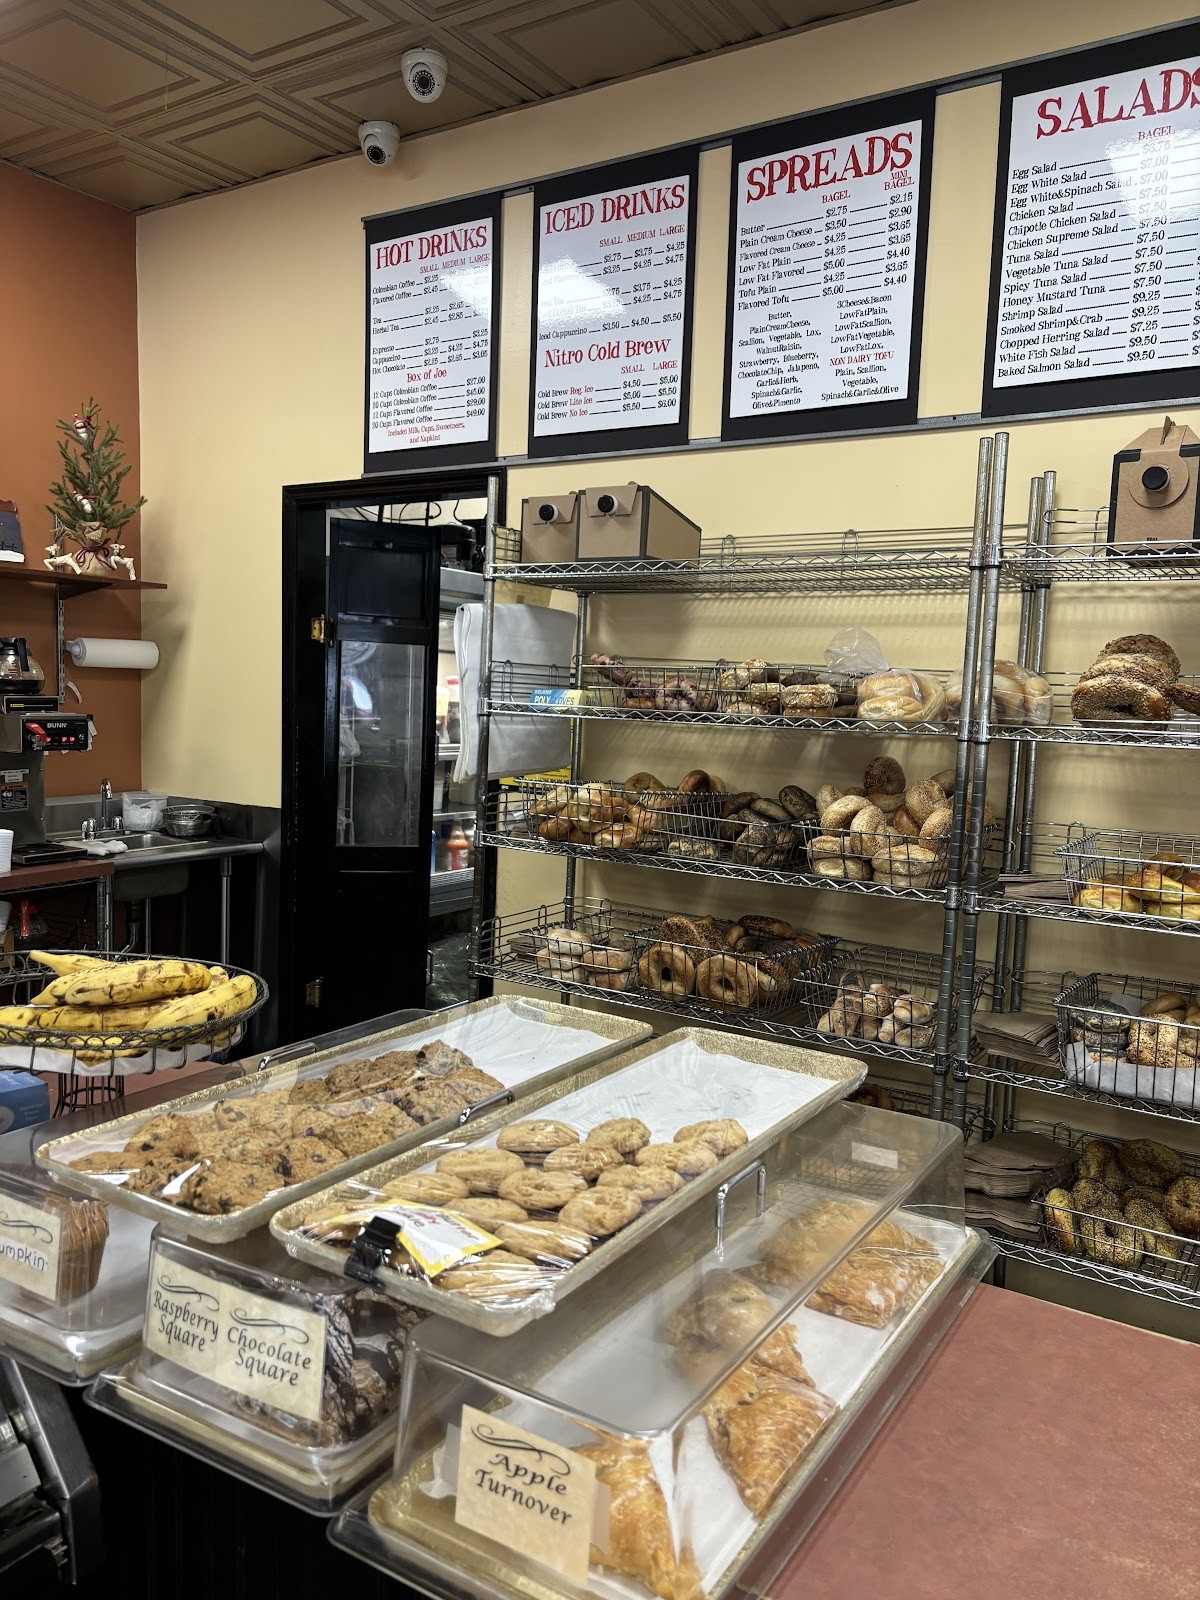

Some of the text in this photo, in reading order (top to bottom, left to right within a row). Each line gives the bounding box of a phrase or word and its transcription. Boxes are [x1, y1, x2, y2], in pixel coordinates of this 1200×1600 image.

[1138, 125, 1175, 141] BAGEL
[746, 132, 913, 204] SPREADS
[1011, 155, 1169, 194] Egg White Salad $7.00
[822, 177, 915, 203] BAGEL BAGEL
[545, 184, 685, 235] ICED DRINKS
[740, 192, 913, 236] Butter $2.75 $2.15
[1008, 221, 1047, 237] Chipotle
[1049, 215, 1087, 229] Chicken
[1090, 210, 1116, 223] Salad
[1009, 208, 1045, 222] Chicken
[1048, 203, 1074, 215] Salad
[600, 225, 685, 247] SMALL MEDIUM LARGE
[740, 206, 912, 248] Plain Cream Cheese $3.50 $2.90
[824, 232, 845, 244] $4.25
[888, 220, 911, 232] $3.65
[1007, 237, 1043, 250] Chicken
[1046, 230, 1089, 245] Supreme
[1092, 224, 1118, 237] Salad
[376, 226, 487, 269] HOT DRINKS
[739, 233, 911, 273] Low Fat Plain $4.25 $3.65
[1006, 245, 1163, 280] Vegetable Tuna Salad $7.50
[1007, 230, 1165, 265] Tuna Salad $7.50
[738, 261, 908, 298] Tofu Plain $4.25 $3.65
[739, 246, 910, 285] Low Fat Flavored $5.00 $4.40
[1003, 260, 1163, 295] Spicy Tuna Salad $7.50
[738, 274, 907, 311] Flavored Tofu $5.00 $4.40
[1002, 291, 1161, 322] Shrimp Salad $9.25
[1003, 275, 1162, 308] Honey Mustard Tuna $7.50
[552, 327, 587, 339] Cappuccino
[602, 321, 620, 331] $3.50
[631, 317, 649, 327] $4.50
[663, 312, 681, 323] $5.50
[1000, 321, 1158, 349] Chopped Herring Salad $7.25
[1001, 320, 1036, 336] Smoked
[1131, 306, 1160, 318] $9.25
[544, 339, 671, 367] Nitro Cold Brew
[830, 351, 894, 367] NON DAIRY TOFU
[998, 350, 1155, 378] Baked Salmon Salad $9.50
[1000, 335, 1157, 363] White Fish Salad $9.50
[407, 368, 447, 382] Box of Joe
[621, 360, 678, 374] SMALL LARGE
[534, 696, 551, 705] POLY
[153, 1290, 218, 1342] Raspberry
[158, 1314, 205, 1351] Square
[228, 1326, 311, 1369] Chocolate
[235, 1348, 299, 1386] Square
[488, 1454, 567, 1496] Apple
[476, 1469, 572, 1524] Turnover
